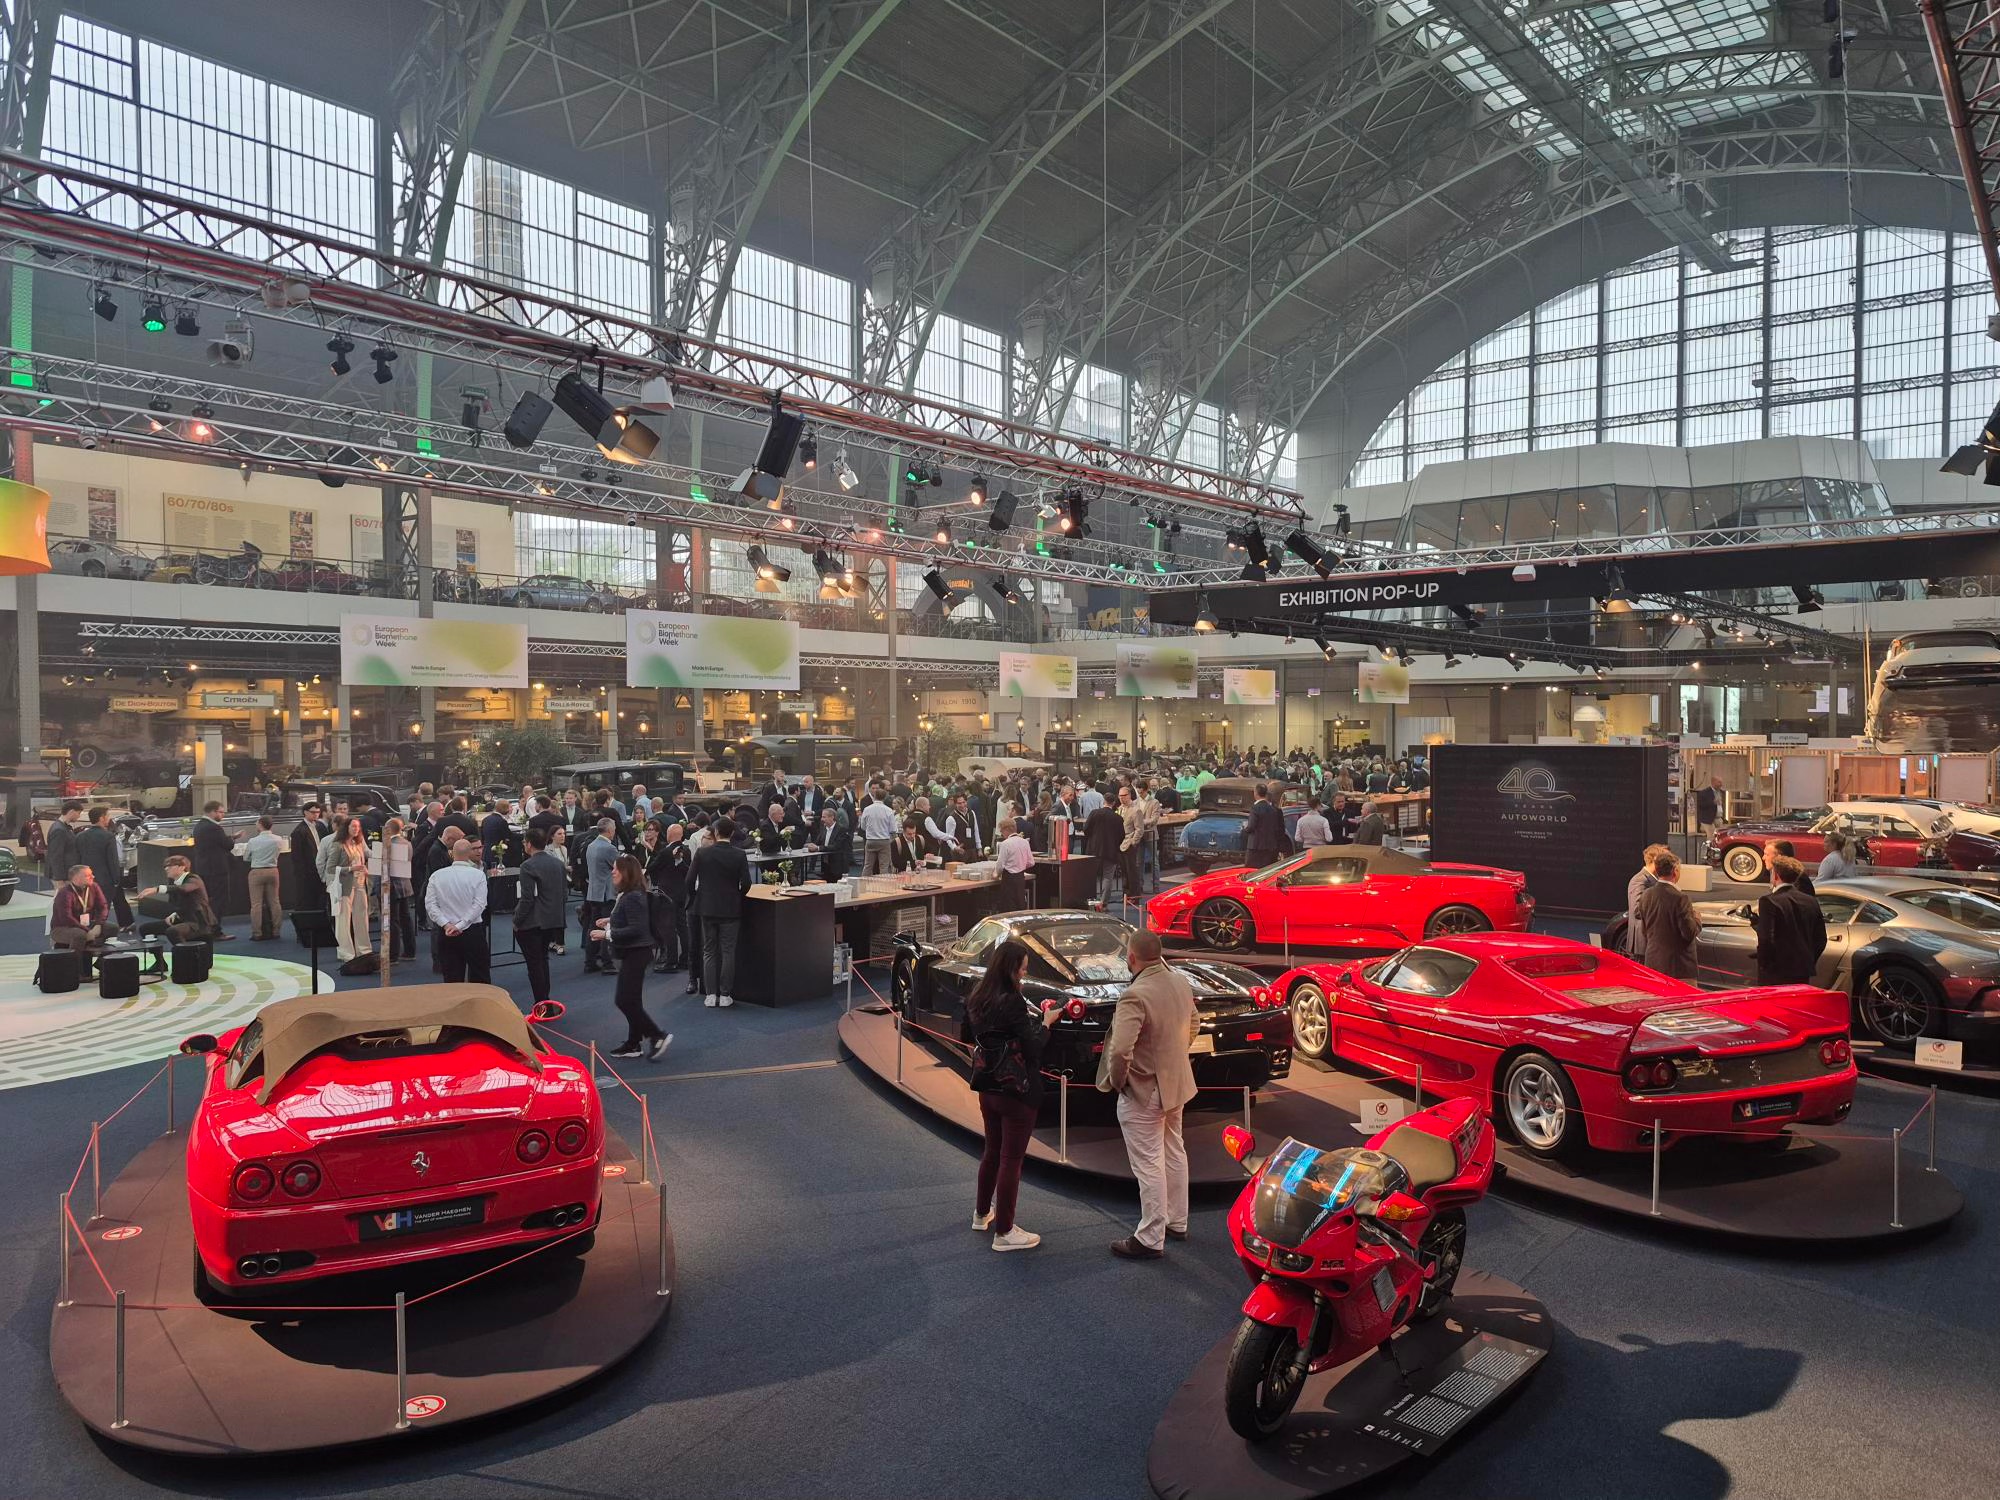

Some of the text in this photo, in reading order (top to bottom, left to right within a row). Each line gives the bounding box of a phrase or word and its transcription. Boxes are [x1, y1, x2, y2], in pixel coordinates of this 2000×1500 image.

[167, 496, 234, 513] 60/70/80s
[1279, 582, 1440, 607] EXHIBITION POP-UP
[374, 624, 409, 633] European
[658, 621, 690, 630] European
[375, 632, 418, 641] Biomethane
[658, 629, 698, 639] Biomethane
[375, 640, 397, 648] Week
[659, 638, 679, 646] Week
[223, 695, 258, 704] CITROËN
[1501, 813, 1568, 823] AUTOWORLD
[414, 1211, 440, 1220] VANDER
[441, 1206, 472, 1216] HAEGHEN
